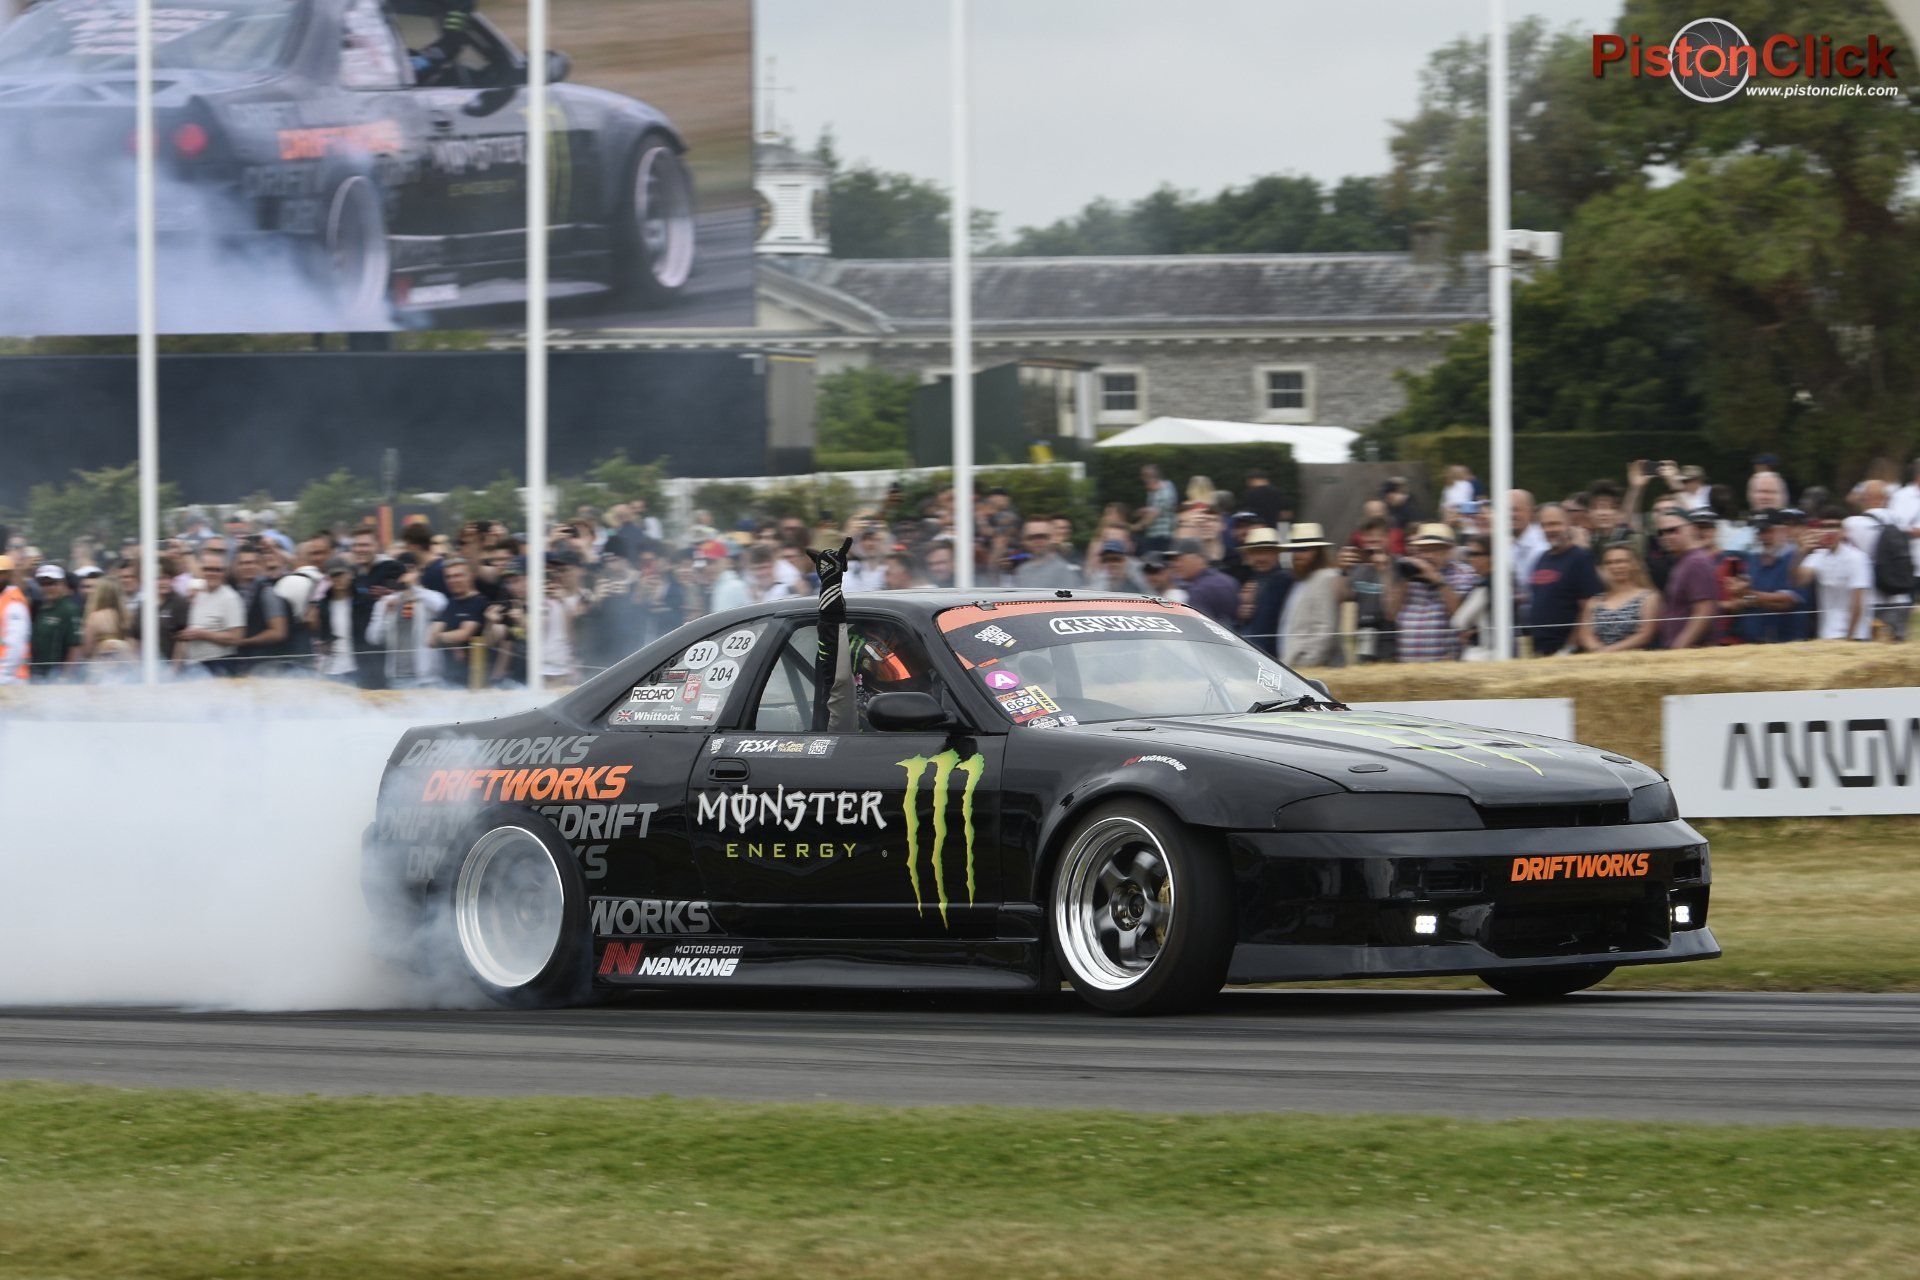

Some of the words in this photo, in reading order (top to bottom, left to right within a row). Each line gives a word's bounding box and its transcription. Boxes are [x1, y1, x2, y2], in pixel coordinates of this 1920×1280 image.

[727, 636, 751, 650] 228
[689, 648, 712, 661] 331
[708, 667, 733, 681] 204
[994, 673, 1016, 687] A
[632, 688, 675, 700] RECARO
[1006, 697, 1034, 710] 663
[634, 711, 680, 721] Whittock
[399, 735, 599, 766] DRIFTWORKS
[735, 740, 778, 754] TESSA
[422, 765, 633, 801] DRIFTWORKS
[697, 784, 887, 833] MONSTER
[727, 843, 856, 858] ENERGY
[1511, 853, 1650, 882] DRIFTWORKS
[675, 945, 743, 954] MOTORSPORT
[638, 957, 739, 977] NANKANG
